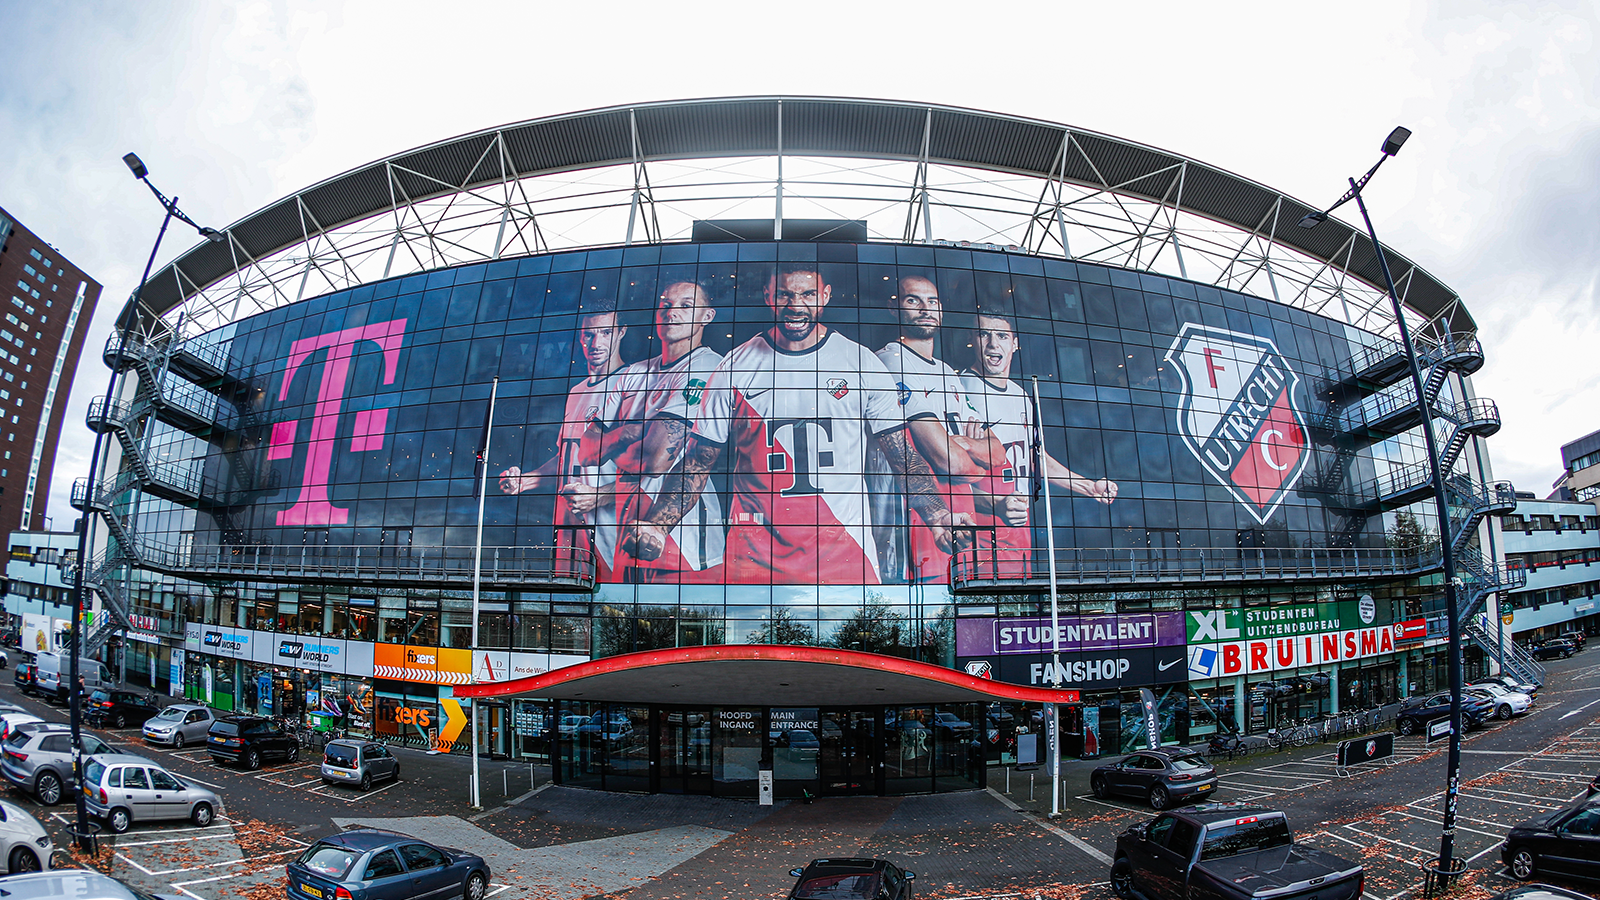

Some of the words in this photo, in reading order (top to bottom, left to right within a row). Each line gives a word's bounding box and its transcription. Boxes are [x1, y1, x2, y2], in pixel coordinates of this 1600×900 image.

[1202, 347, 1225, 389] F
[267, 318, 407, 525] T
[1204, 354, 1286, 472] UTRECHT
[766, 417, 835, 498] T
[1260, 428, 1288, 472] C
[1246, 607, 1315, 622] STUDENTEN
[1000, 622, 1152, 645] STUDENTALENT
[1190, 610, 1240, 642] XL
[1247, 619, 1340, 637] UITZENDBUREAU
[221, 641, 241, 651] WORLD
[222, 633, 249, 644] RUNNERS
[302, 651, 329, 663] WORLD
[303, 643, 340, 656] RUNNERS
[407, 649, 436, 665] fixers
[1223, 628, 1394, 674] BRUINSMA
[477, 652, 498, 681] A
[496, 660, 503, 668] D
[1030, 658, 1130, 685] FANSHOP
[378, 697, 430, 727] fixers
[720, 711, 752, 719] HOOFD
[720, 721, 755, 729] INGANG
[770, 721, 818, 729] ENTRANCE
